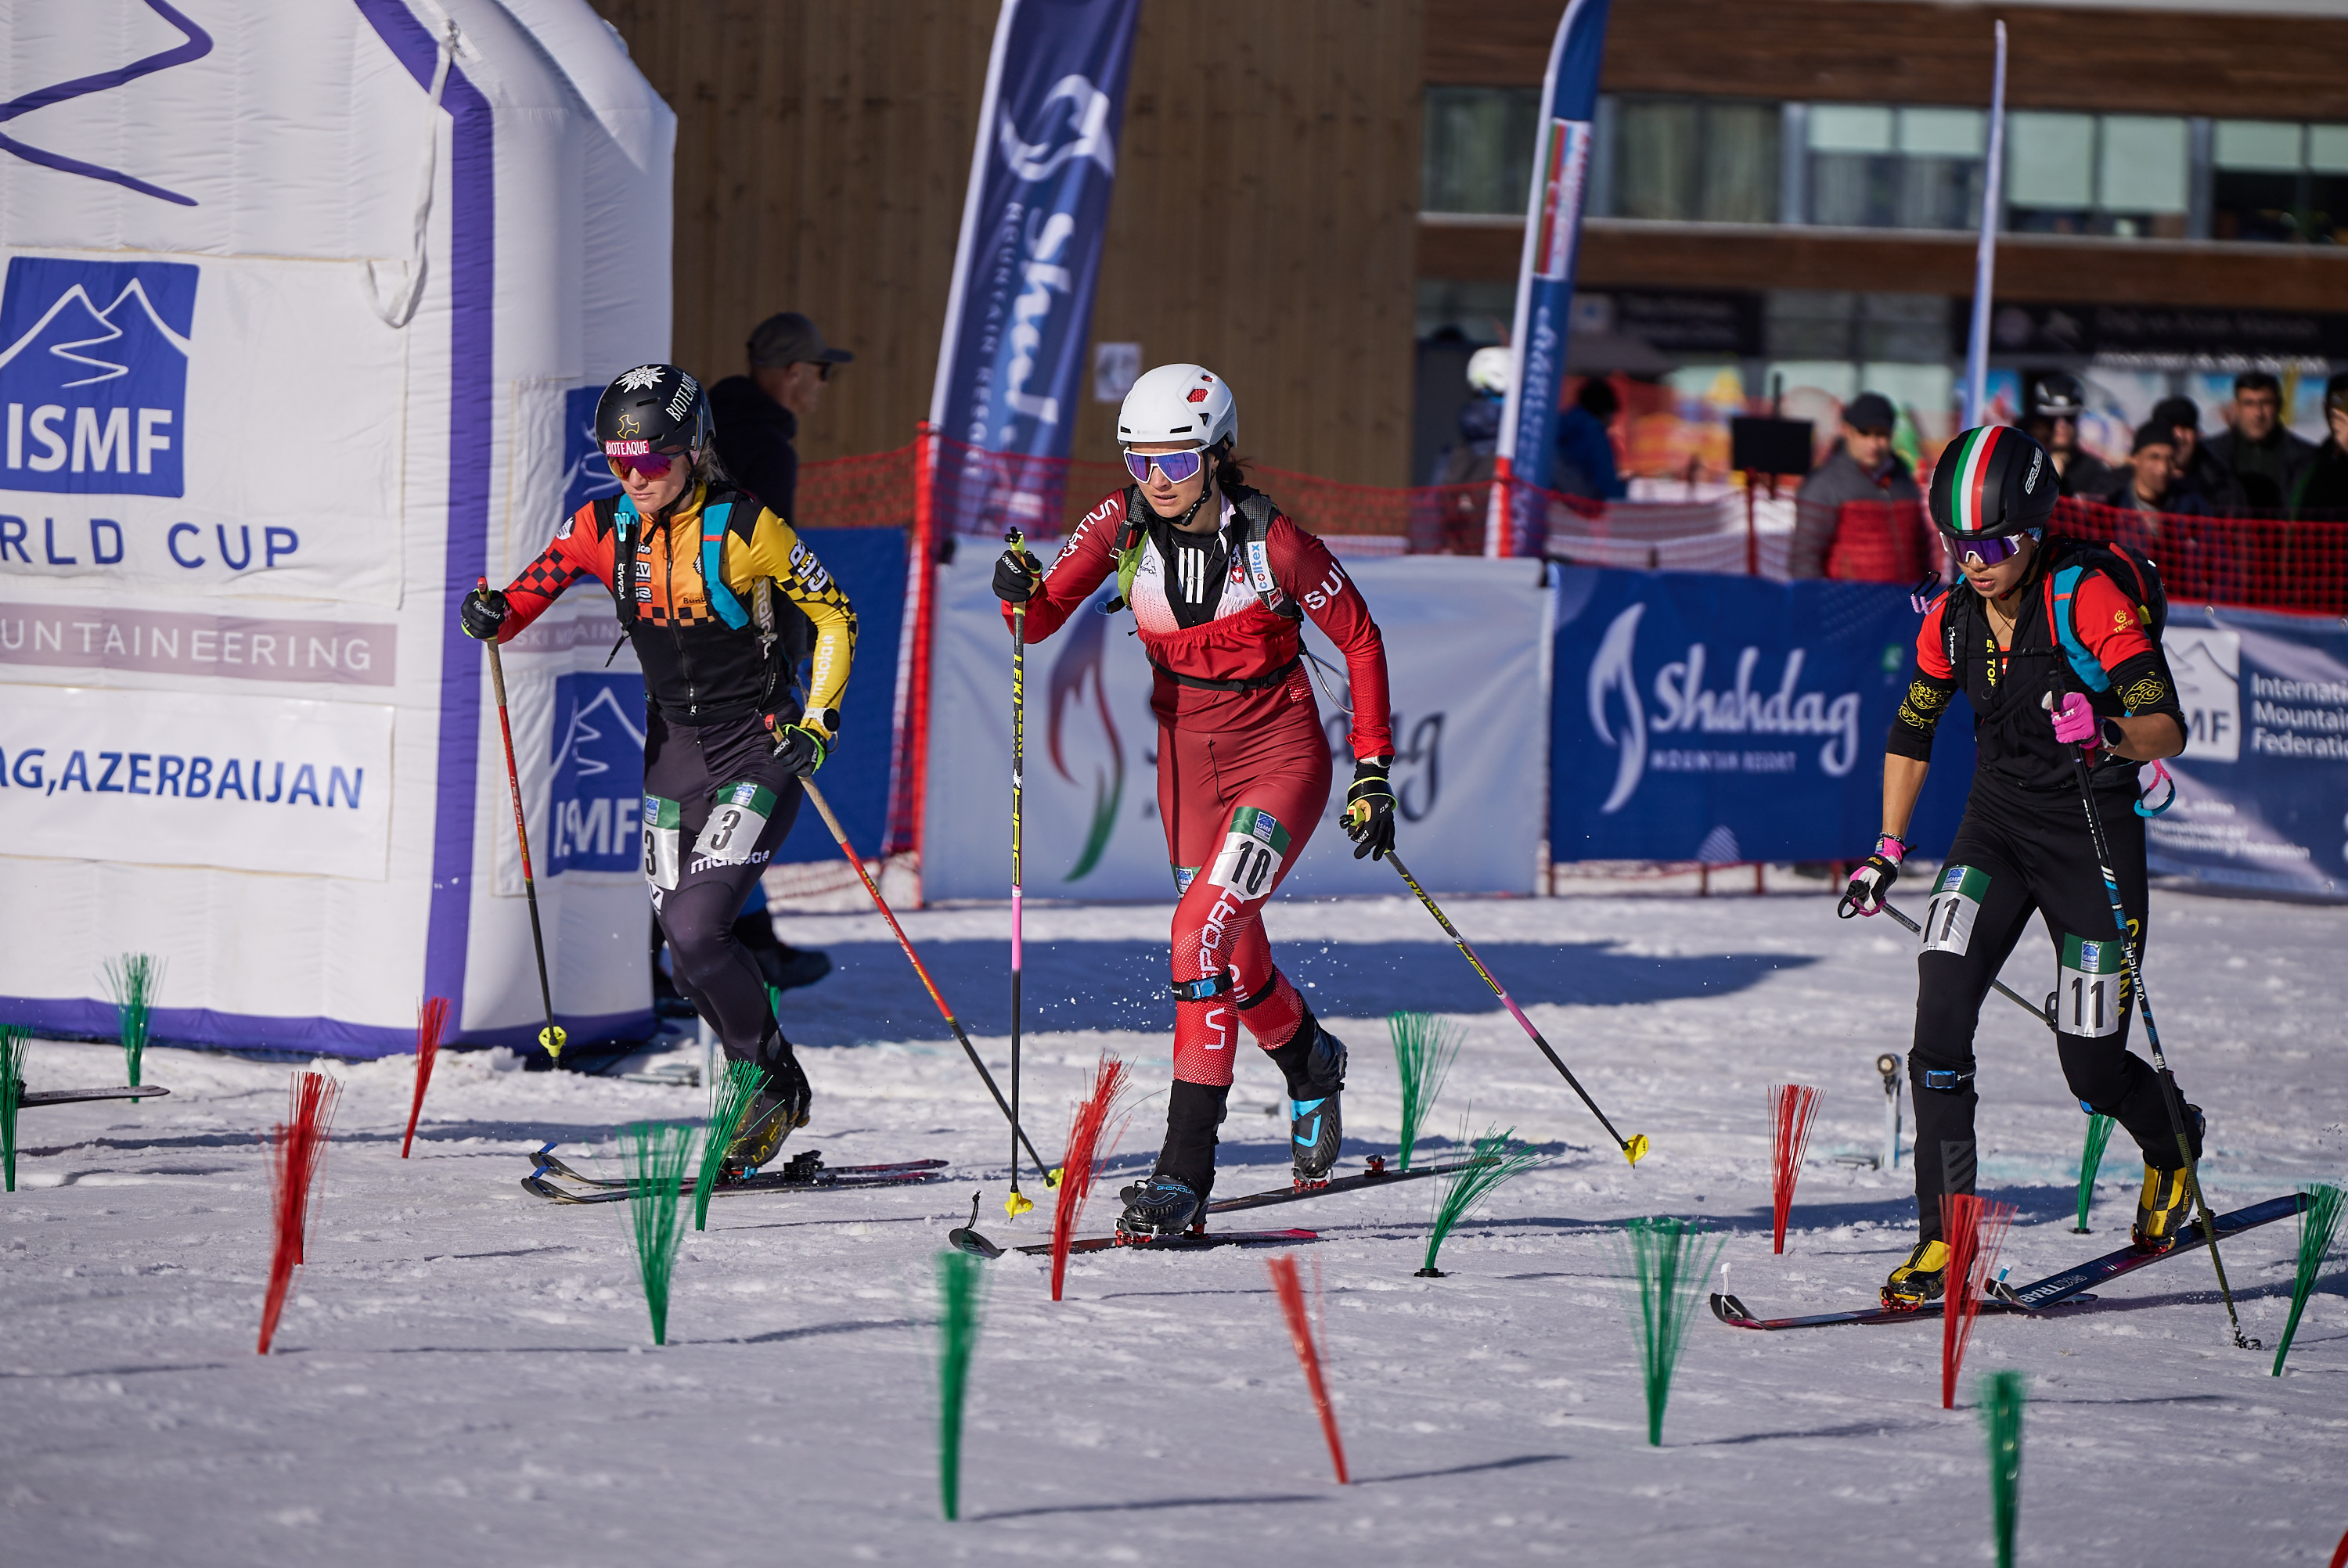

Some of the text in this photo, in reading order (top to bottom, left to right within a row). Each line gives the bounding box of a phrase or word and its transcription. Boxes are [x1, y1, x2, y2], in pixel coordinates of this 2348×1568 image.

[6, 402, 173, 475] ISMF
[606, 441, 648, 455] BIOTEAQUE
[167, 522, 300, 571] CUP
[1251, 543, 1268, 590] colltex
[1305, 560, 1345, 610] SUI
[473, 599, 501, 620] Roeckl
[2113, 619, 2134, 633] TECTOP
[812, 646, 834, 696] maloja
[1013, 653, 1023, 704] LEKI
[1651, 642, 1860, 776] Shahdag
[710, 810, 741, 851] 3
[1257, 822, 1271, 833] ISMF
[644, 830, 657, 876] 3
[1231, 841, 1271, 895] 10
[1923, 897, 1961, 943] 11
[2125, 941, 2146, 1002] VERTICAL
[2071, 977, 2104, 1028] 11
[1205, 1007, 1226, 1050] LA
[1156, 1185, 1196, 1196] GIGNOUX
